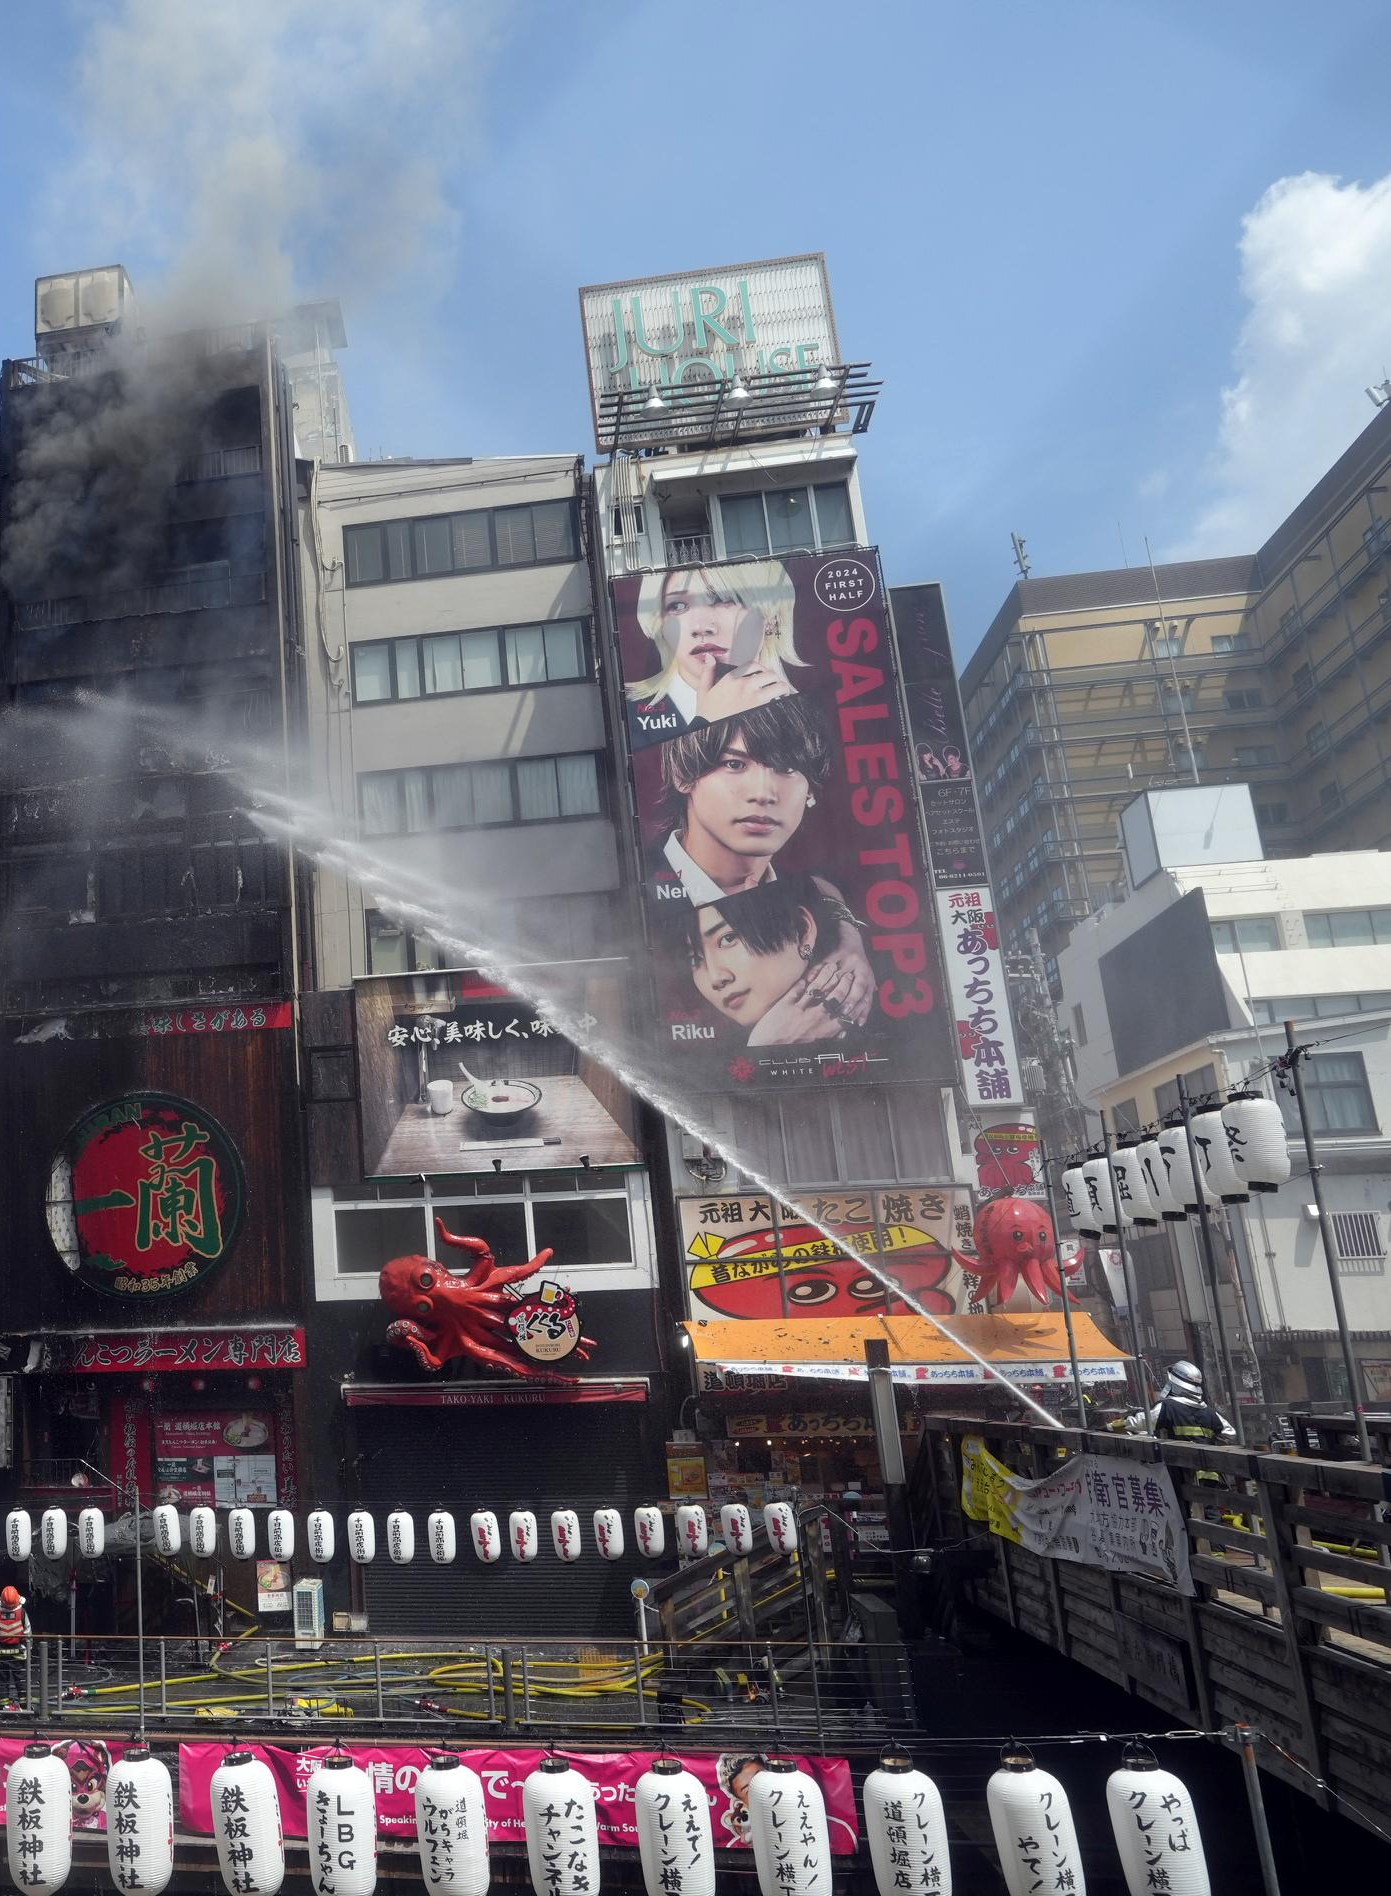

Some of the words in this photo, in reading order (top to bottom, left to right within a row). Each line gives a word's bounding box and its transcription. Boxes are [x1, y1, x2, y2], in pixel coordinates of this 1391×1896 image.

[610, 280, 757, 374] JURI
[825, 579, 864, 590] FIRST
[827, 568, 858, 579] 2024
[829, 590, 863, 601] HALF
[637, 714, 677, 731] Yuki
[948, 892, 982, 908] 元祖
[951, 909, 985, 925] 大阪
[956, 927, 1012, 1100] あっちち本舗
[387, 1012, 598, 1048] 安心、美味しく、味中
[671, 1024, 715, 1041] Riku
[770, 1068, 814, 1076] WHITE
[75, 1121, 223, 1259] 一蘭
[526, 1312, 567, 1340] くくる
[504, 1393, 546, 1403] KUKURU
[16, 1776, 47, 1887] 鉄板神社
[112, 1780, 144, 1889] 鉄板神社
[337, 1794, 356, 1871] LBG
[455, 1797, 470, 1841] 道頓堀
[221, 1784, 260, 1894] 鉄板神社
[883, 1800, 912, 1888] 道頓堀店
